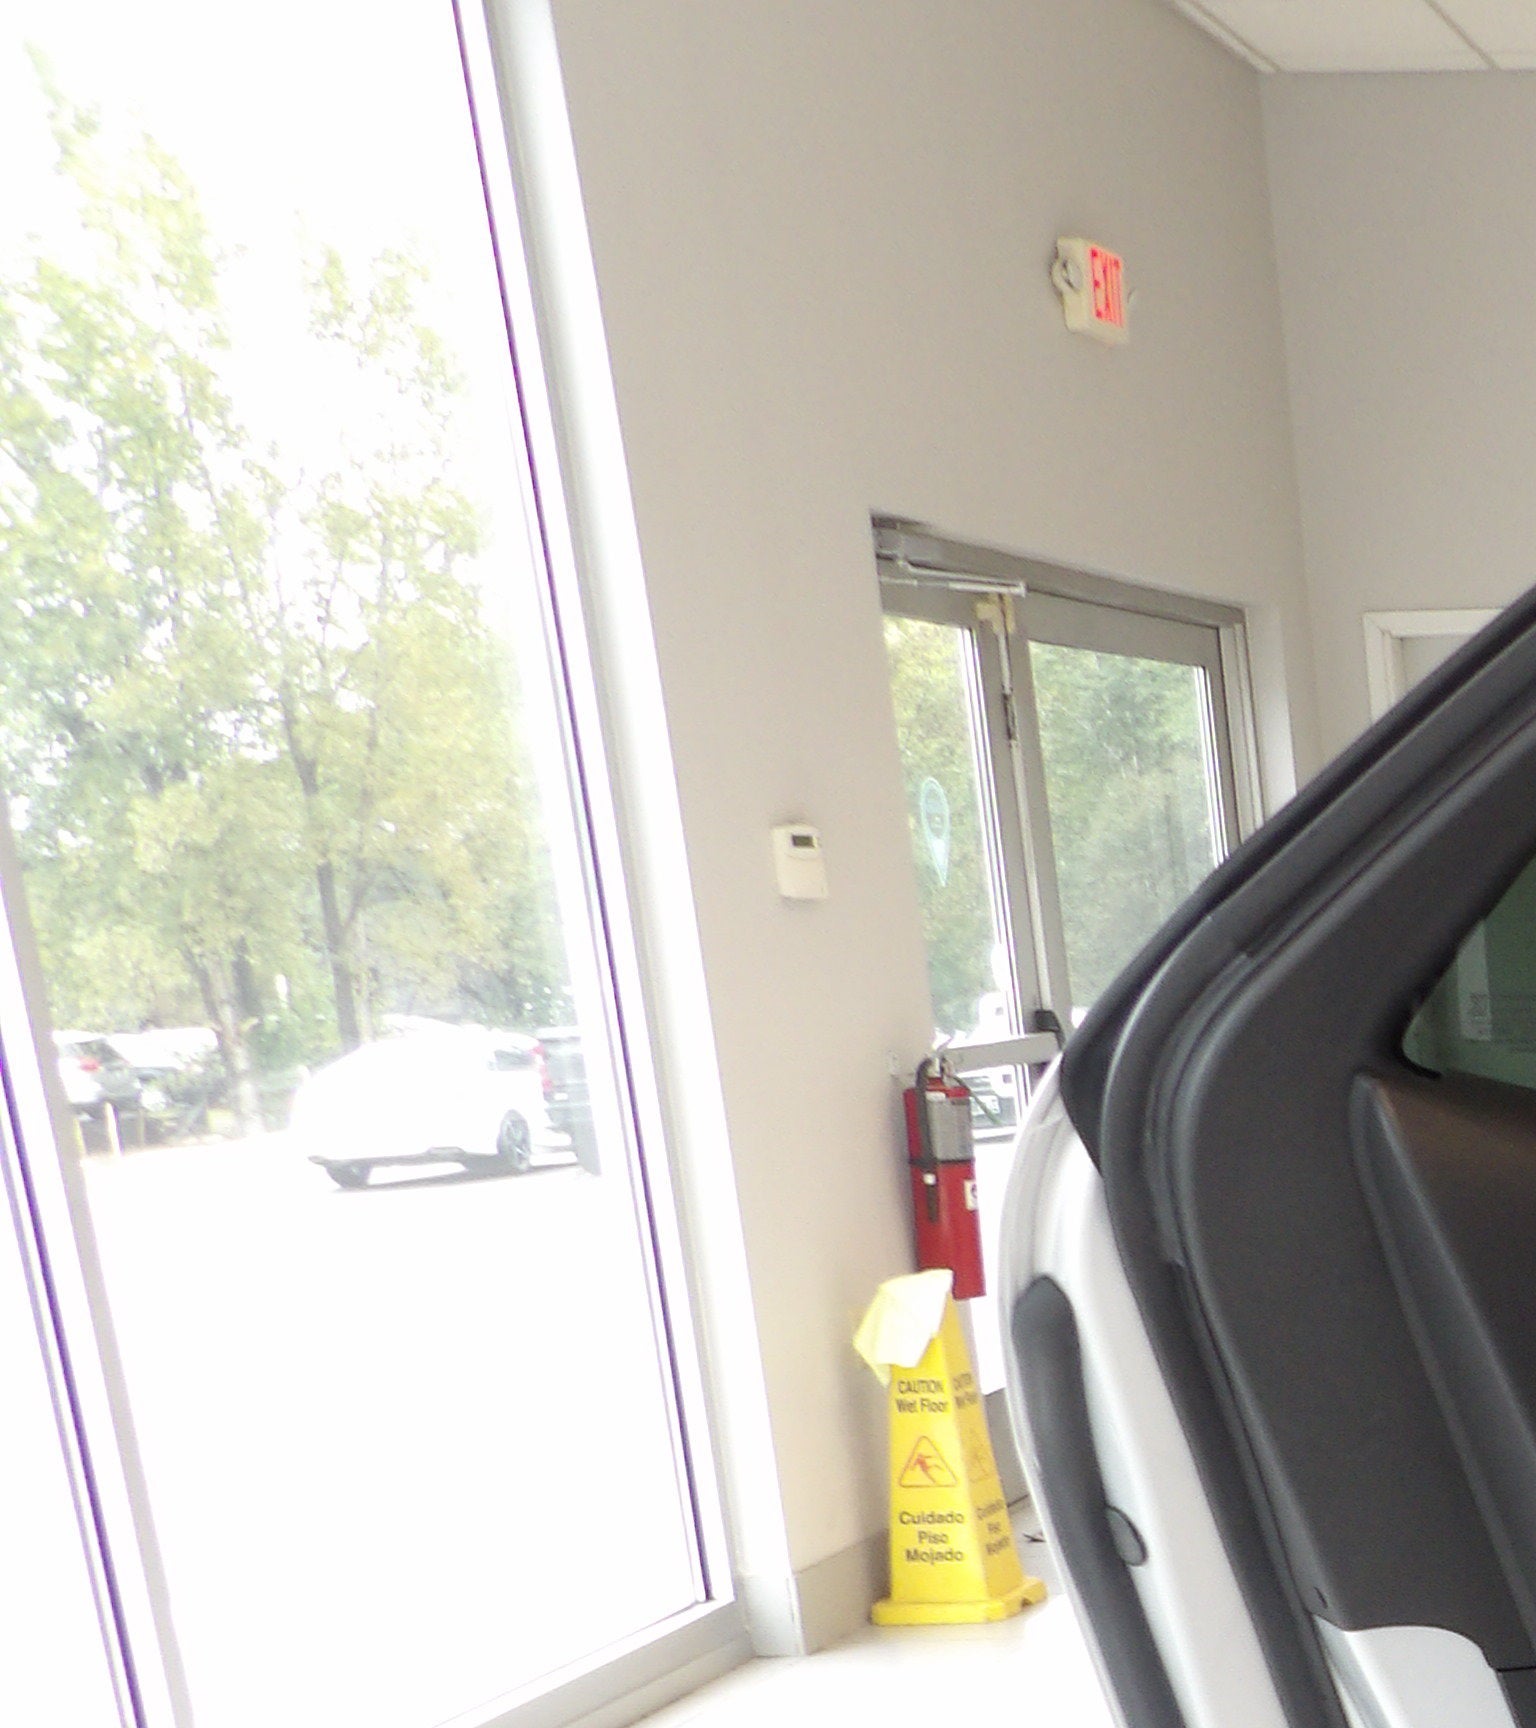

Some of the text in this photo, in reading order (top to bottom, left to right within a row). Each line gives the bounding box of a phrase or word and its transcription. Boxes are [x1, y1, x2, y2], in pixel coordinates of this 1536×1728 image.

[898, 1378, 945, 1395] CAUTION
[896, 1397, 918, 1414] Wet
[920, 1396, 948, 1414] Floor
[899, 1509, 965, 1525] Cuidado
[917, 1530, 949, 1545] Piso
[905, 1547, 965, 1566] Mojado
